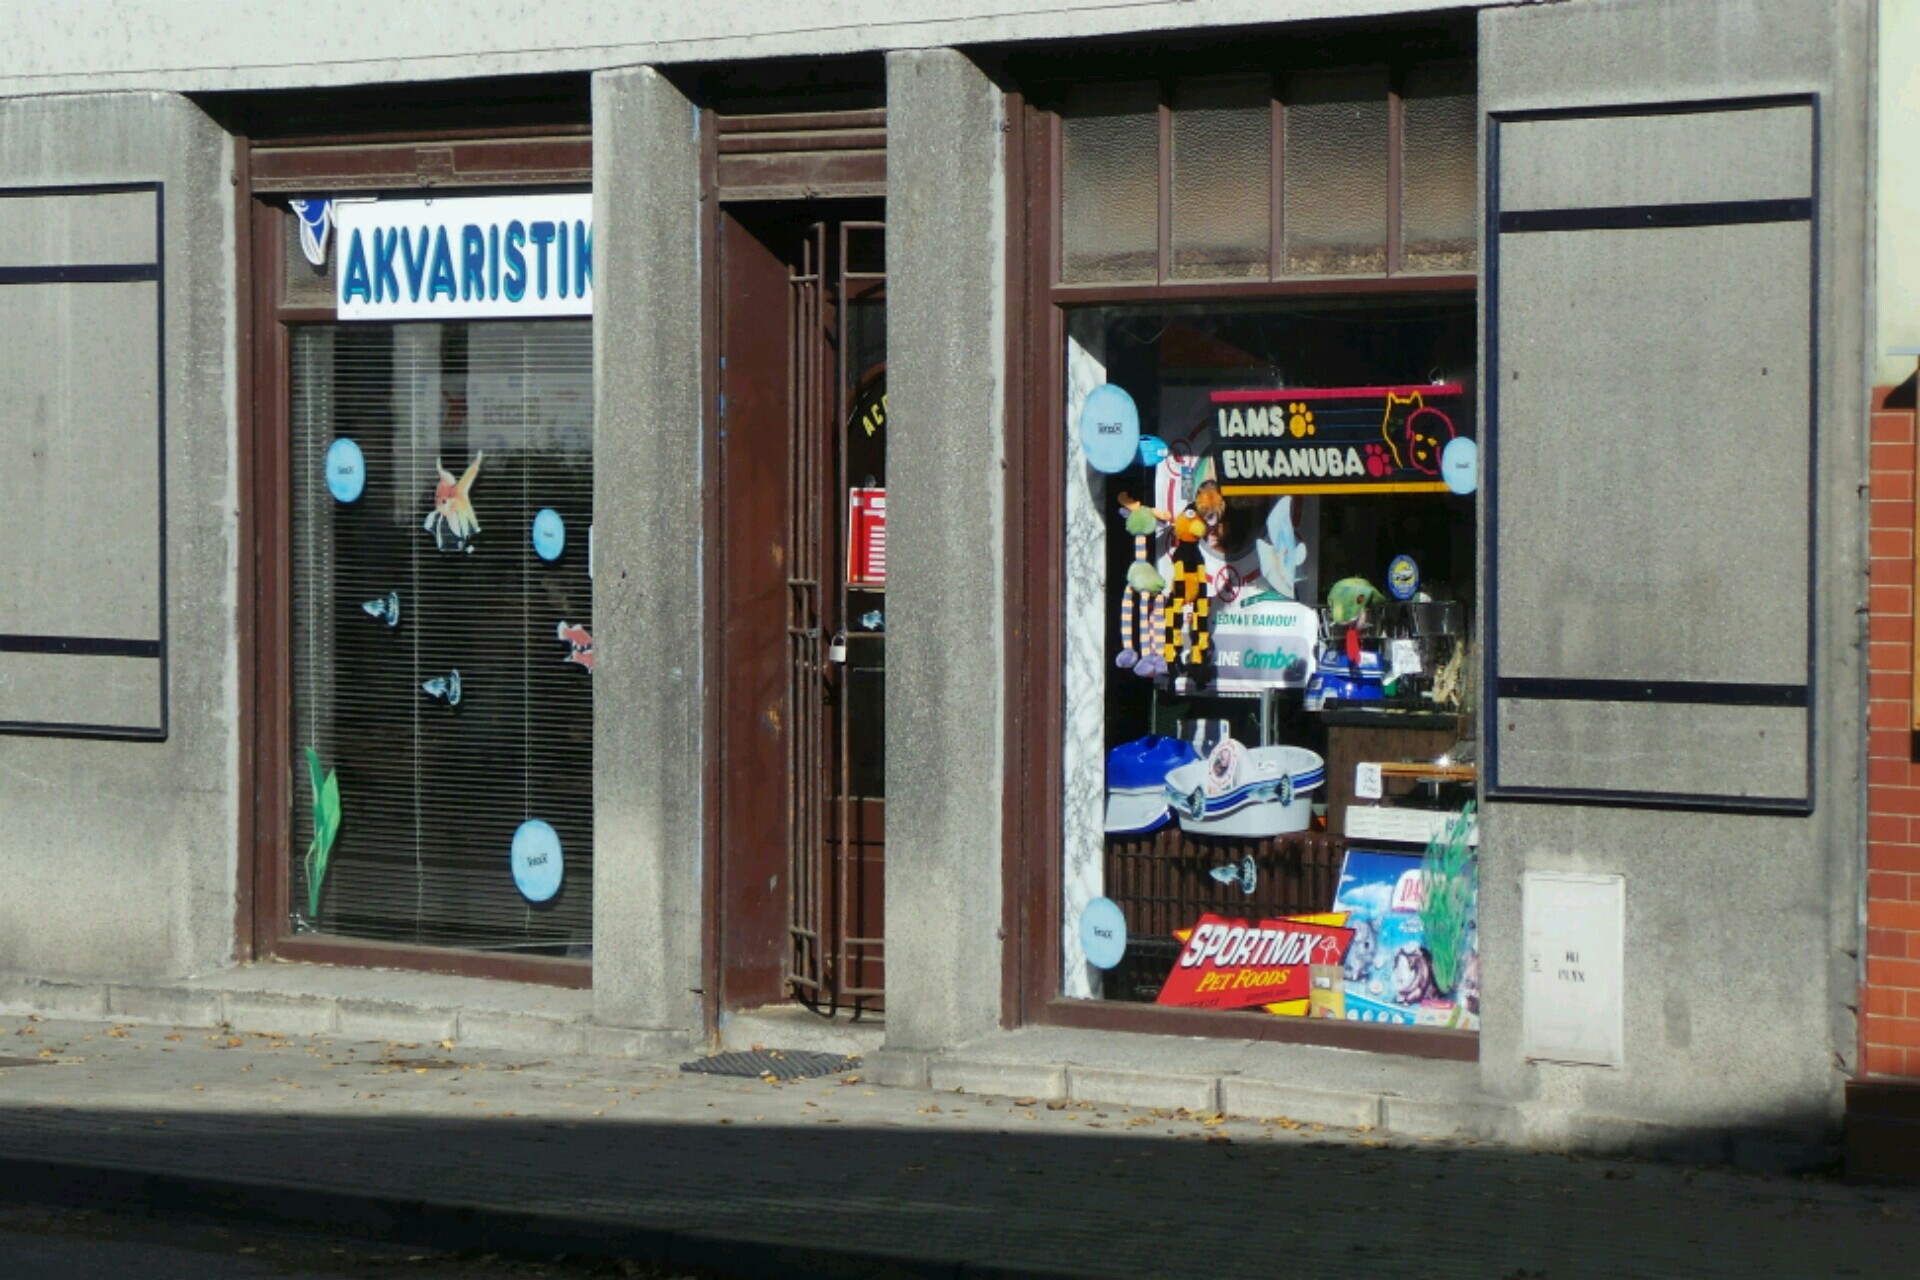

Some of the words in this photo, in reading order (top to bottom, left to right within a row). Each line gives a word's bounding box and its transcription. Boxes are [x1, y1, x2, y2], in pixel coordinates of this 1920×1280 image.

[1218, 406, 1285, 437] IAMS
[1222, 446, 1366, 479] EUKANUBA
[1195, 971, 1236, 993] PET
